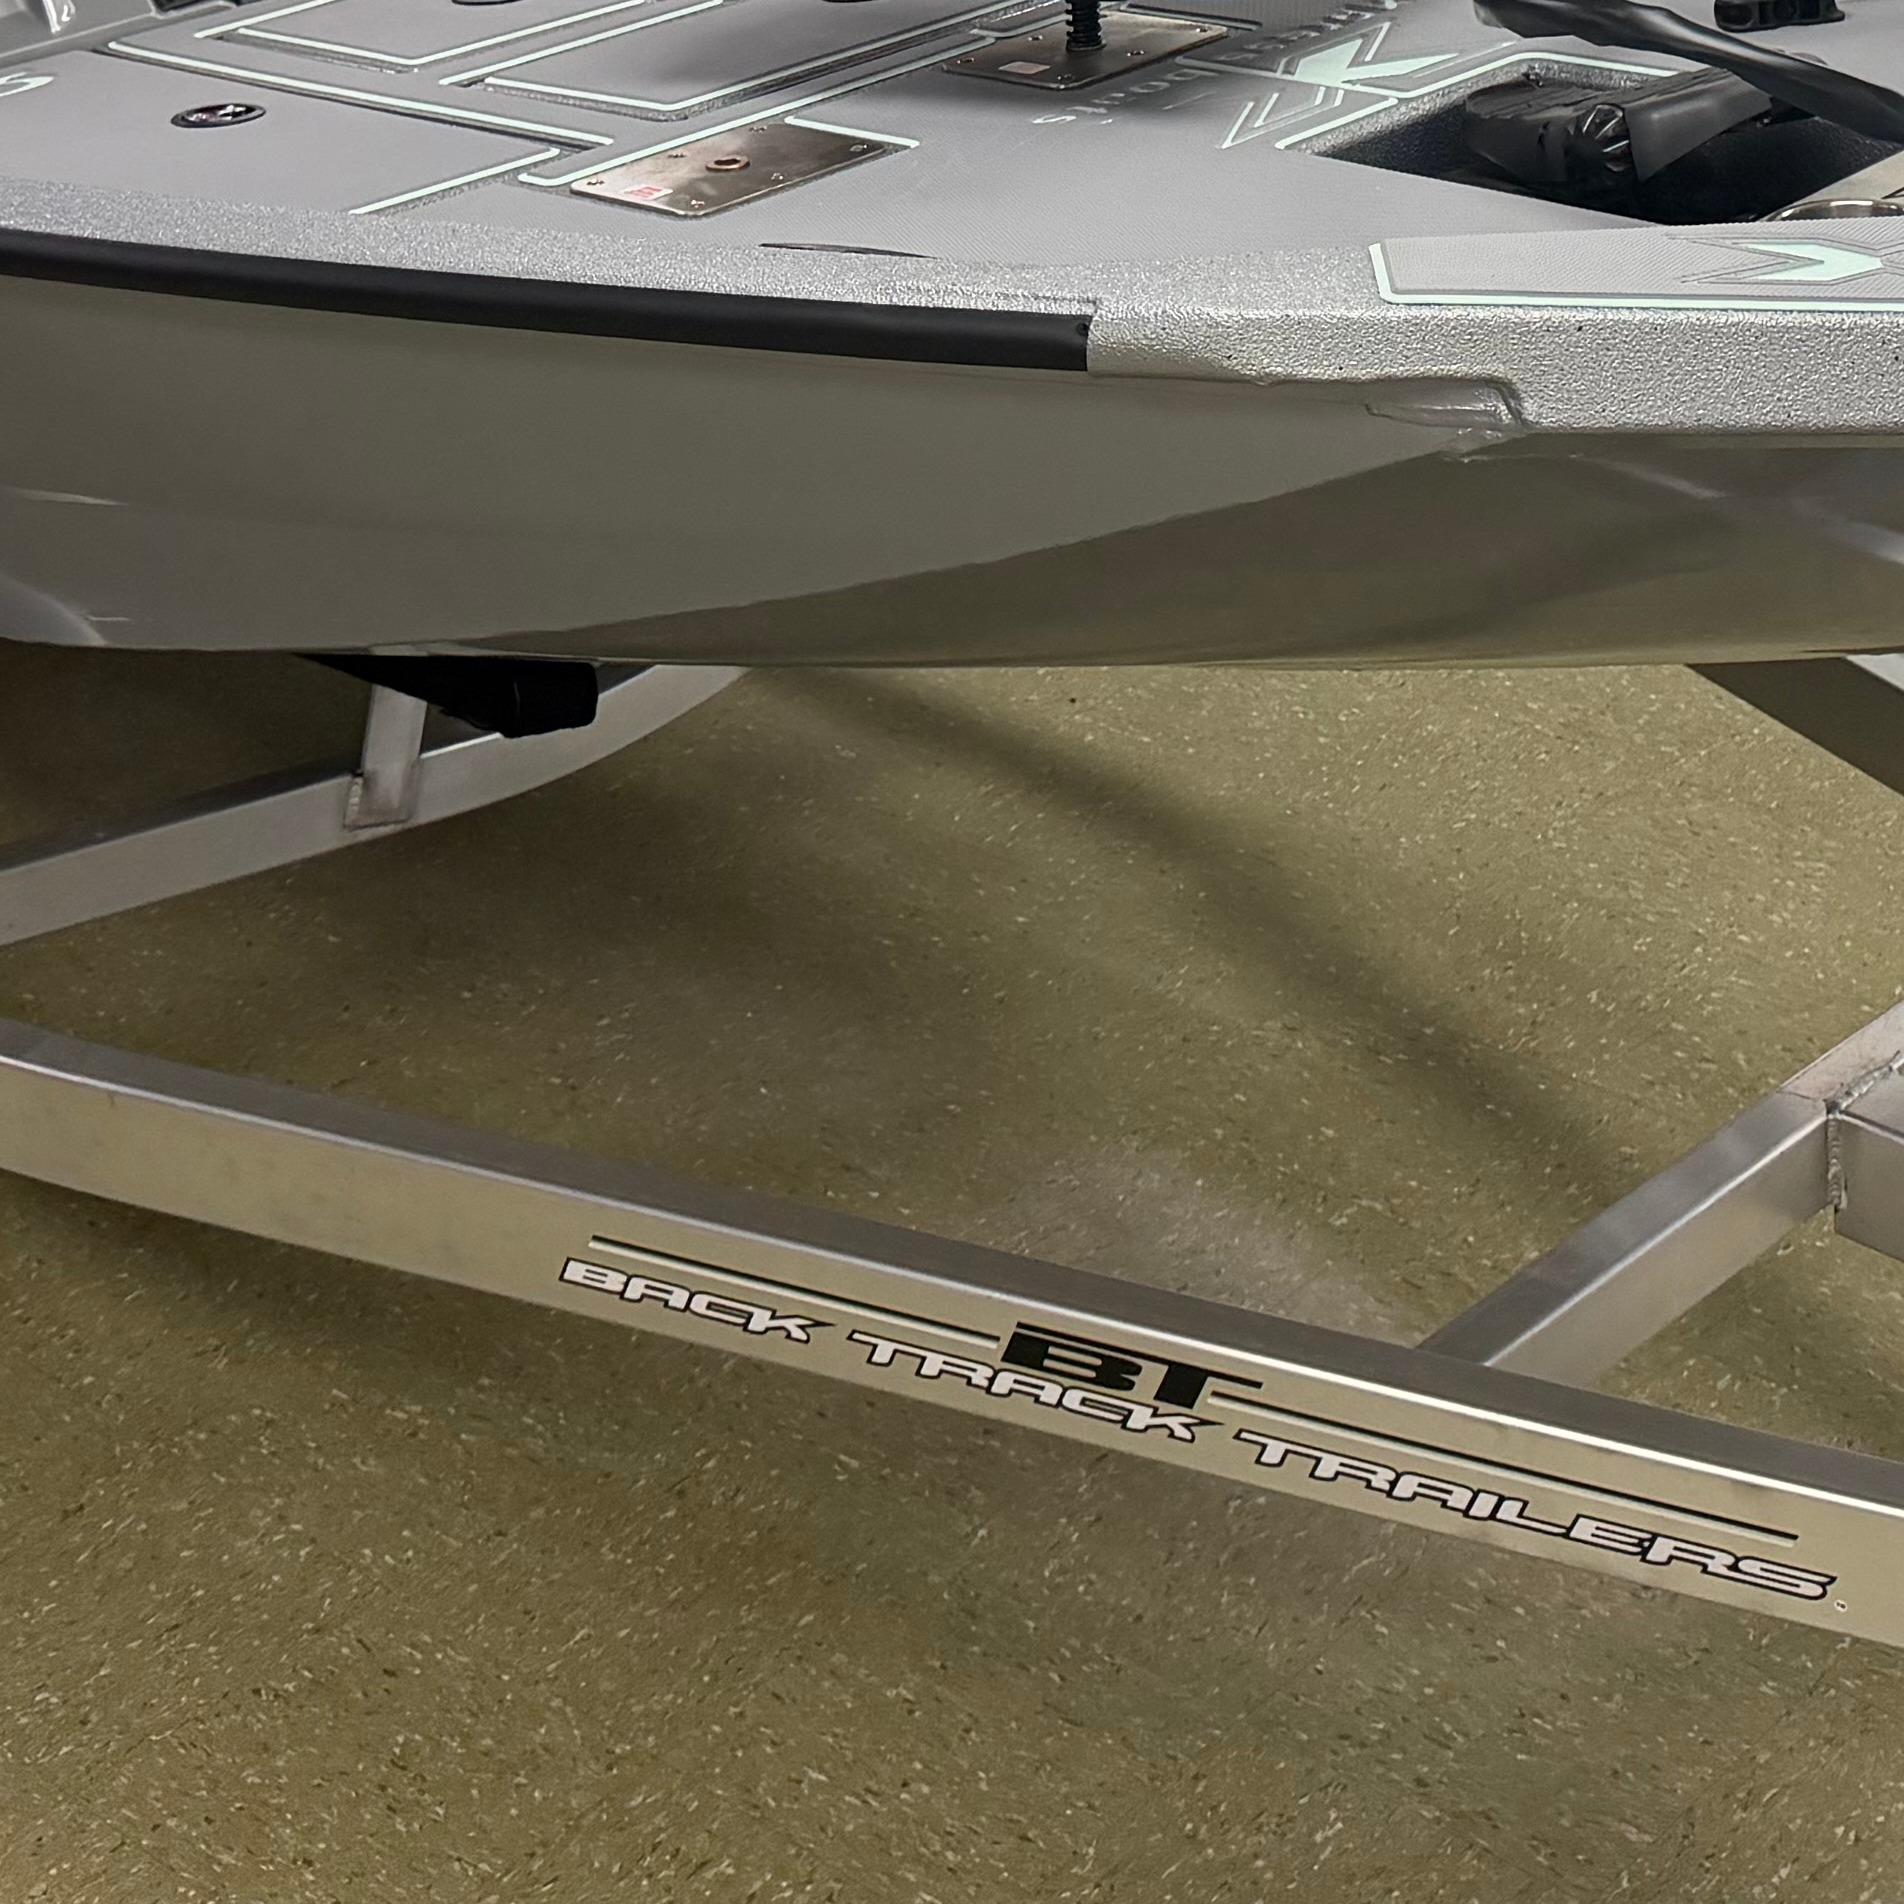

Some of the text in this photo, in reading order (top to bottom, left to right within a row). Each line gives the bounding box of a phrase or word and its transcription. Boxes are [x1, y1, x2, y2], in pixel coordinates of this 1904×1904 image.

[558, 1256, 1837, 1600] BACK TRACK TRAILERS
[1001, 1322, 1263, 1410] BT
